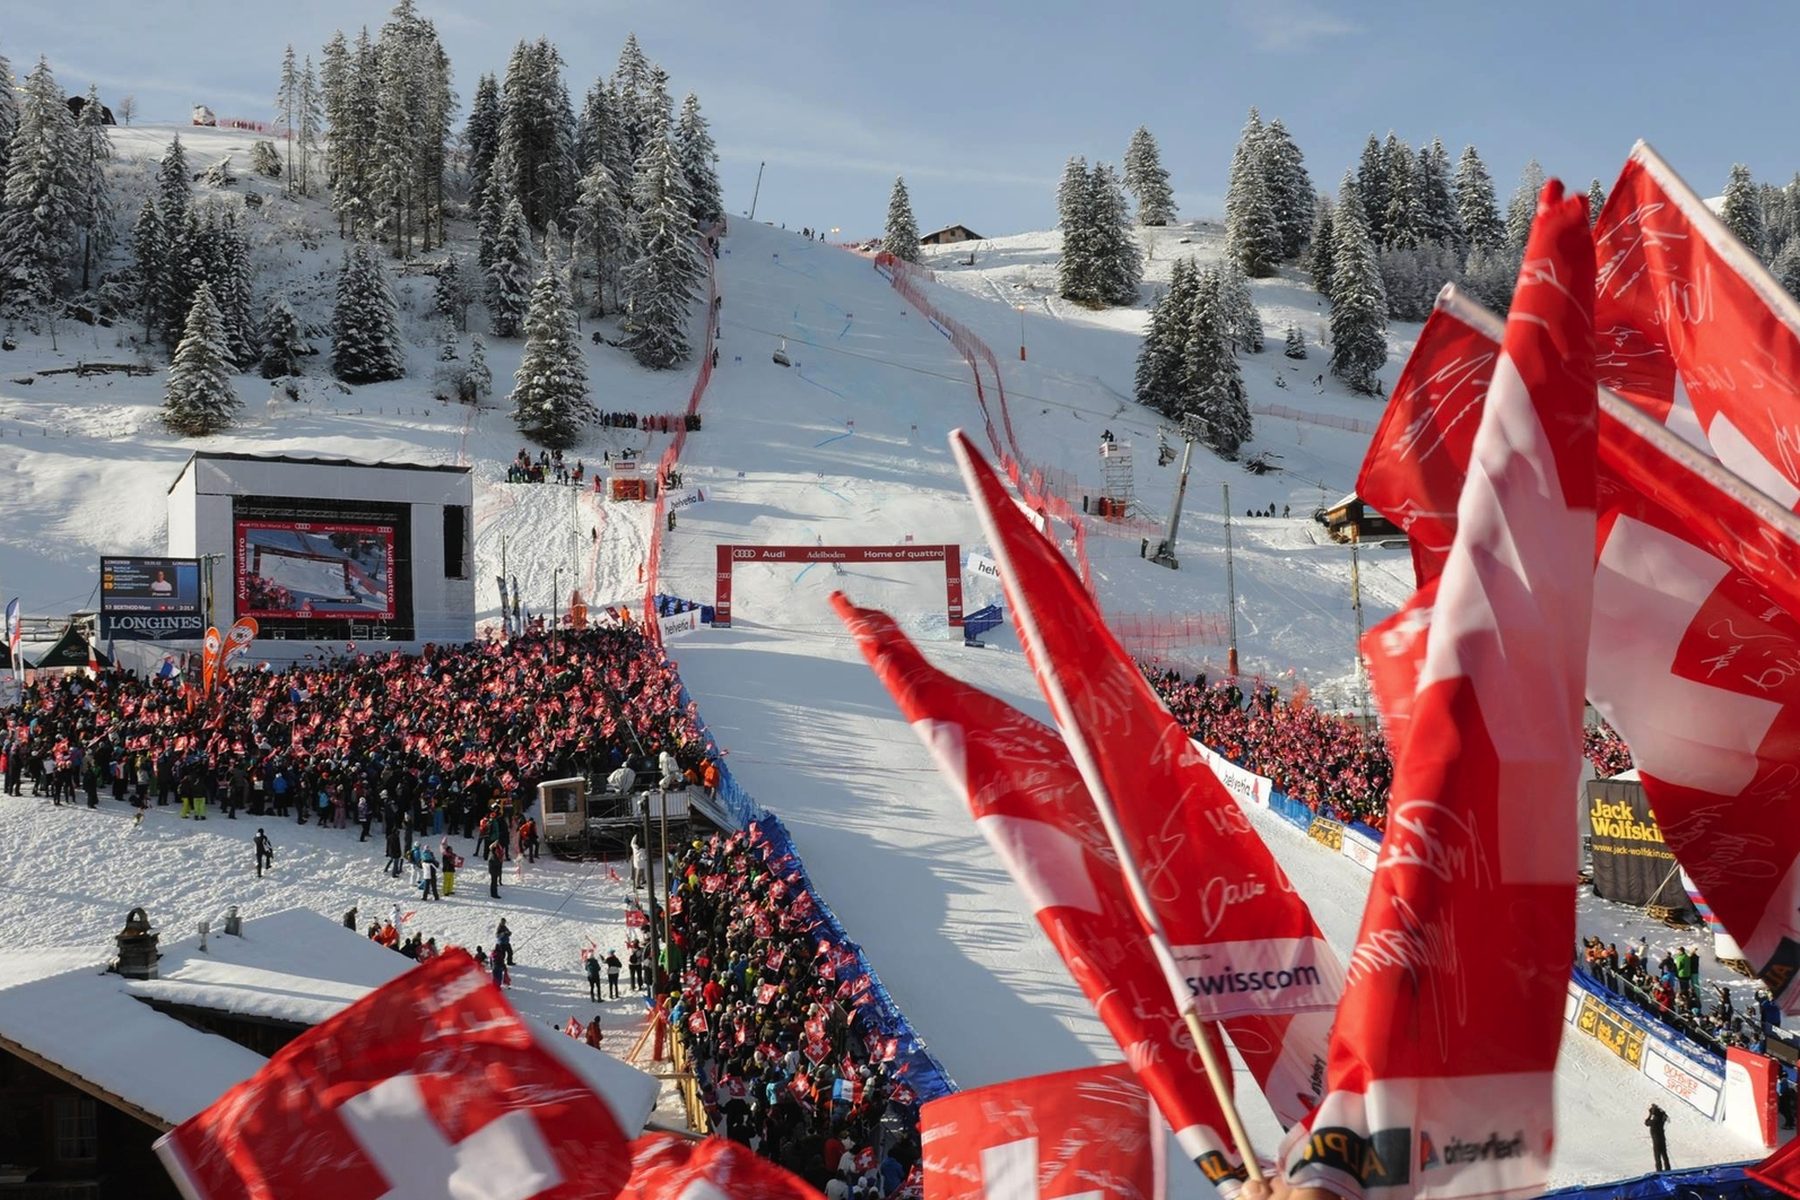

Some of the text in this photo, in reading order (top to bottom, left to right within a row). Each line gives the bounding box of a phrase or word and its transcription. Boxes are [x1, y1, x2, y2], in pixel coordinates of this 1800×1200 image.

[864, 550, 893, 558] Home
[894, 550, 906, 558] of
[907, 550, 944, 558] quattro
[239, 538, 248, 600] Audi quattro
[387, 567, 395, 603] quattro
[109, 616, 202, 629] LONGINES
[664, 618, 689, 636] helvetia
[1590, 798, 1634, 820] Jack
[1186, 965, 1321, 997] swisscom
